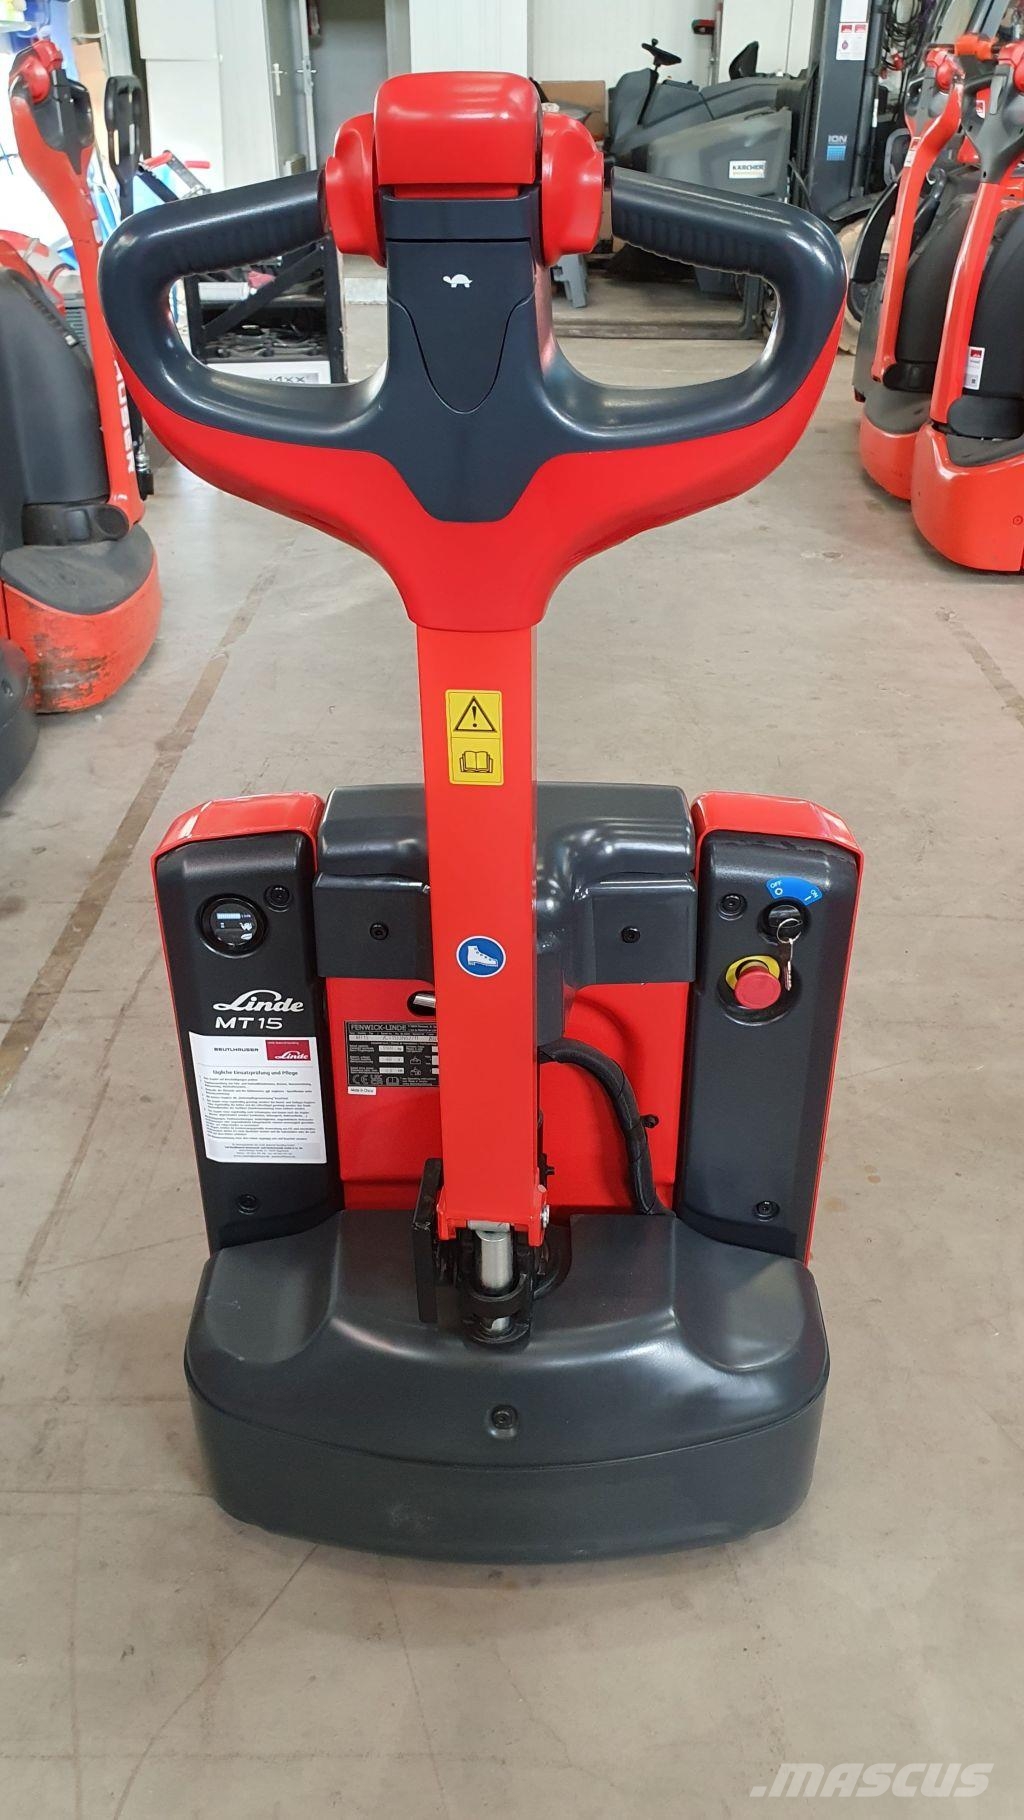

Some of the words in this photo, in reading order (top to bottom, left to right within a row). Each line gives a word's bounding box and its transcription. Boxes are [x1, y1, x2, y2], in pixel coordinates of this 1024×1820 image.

[827, 135, 848, 143] ION
[770, 880, 783, 889] OFF
[811, 889, 819, 898] ON
[213, 989, 305, 1012] Linde
[215, 1016, 254, 1029] MT
[258, 1017, 283, 1030] 15
[274, 1050, 309, 1060] Linde
